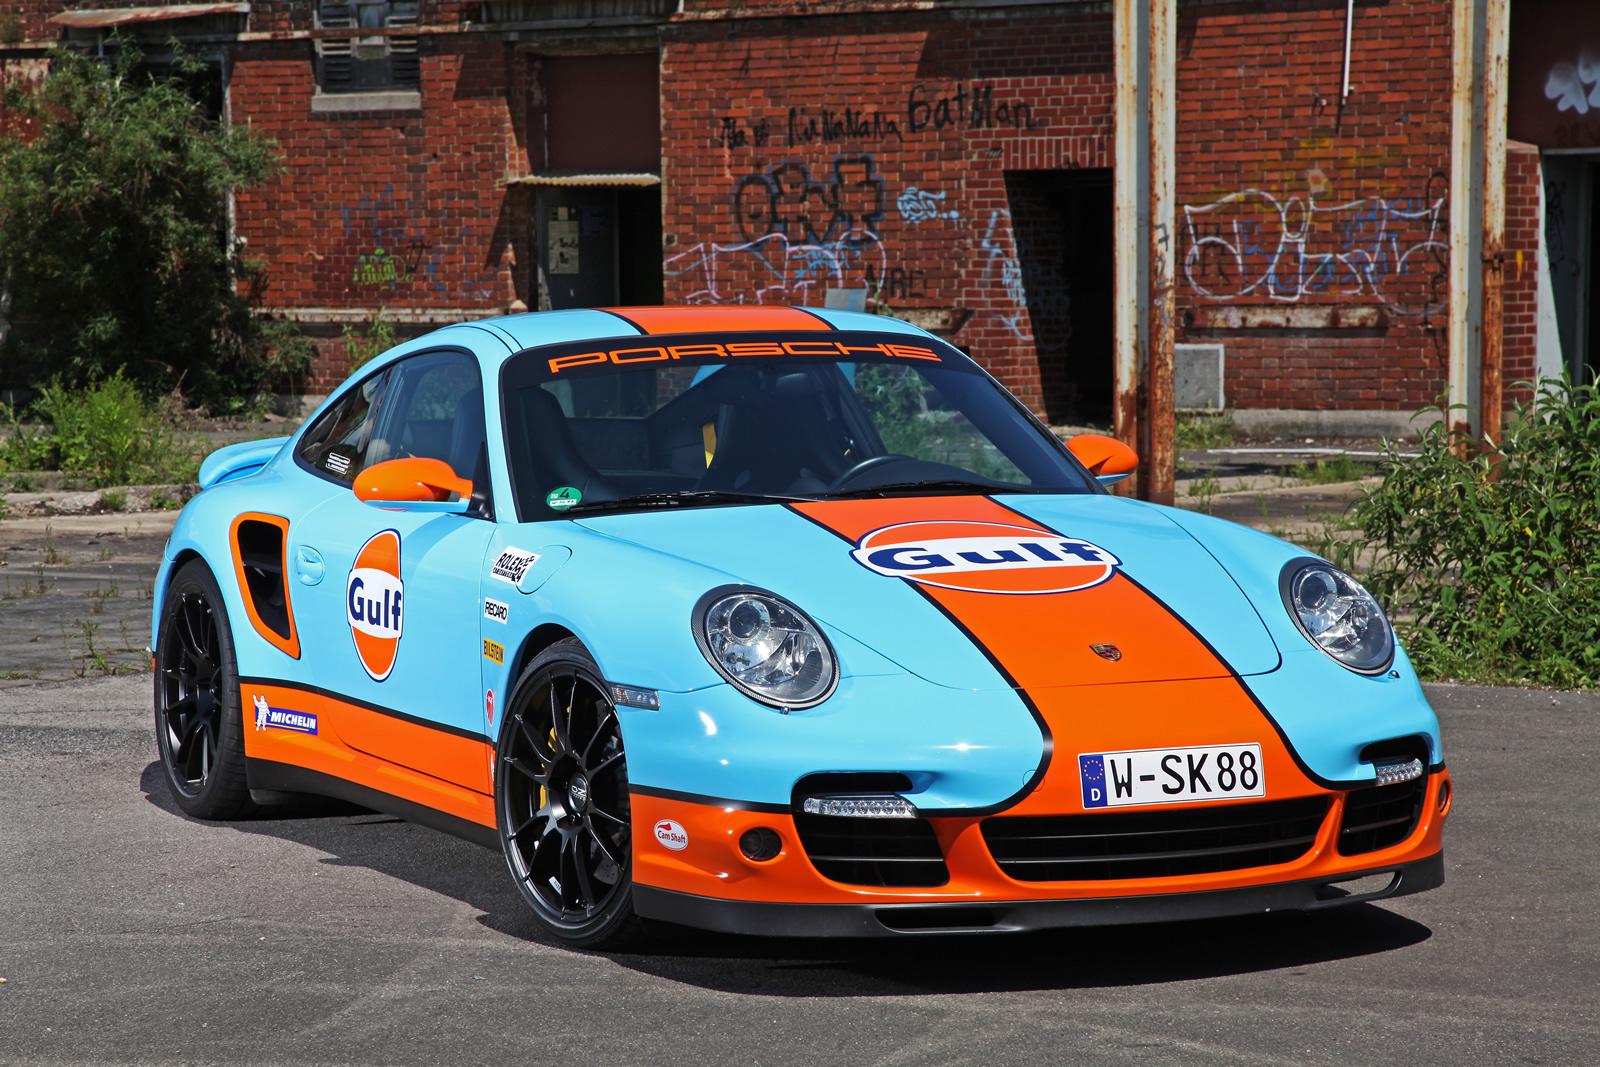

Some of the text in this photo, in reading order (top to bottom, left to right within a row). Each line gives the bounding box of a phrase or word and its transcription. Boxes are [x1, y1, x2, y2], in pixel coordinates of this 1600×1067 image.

[548, 341, 943, 374] PORSCHE
[559, 488, 571, 498] 4
[495, 553, 524, 571] ROLEX
[867, 541, 1104, 571] Gulf
[348, 576, 402, 632] Gulf
[484, 601, 508, 620] RECARO
[483, 640, 504, 663] BILSTEIN
[270, 711, 317, 729] MICHELIN
[1091, 788, 1101, 802] D
[657, 830, 686, 844] Cam Shaft
